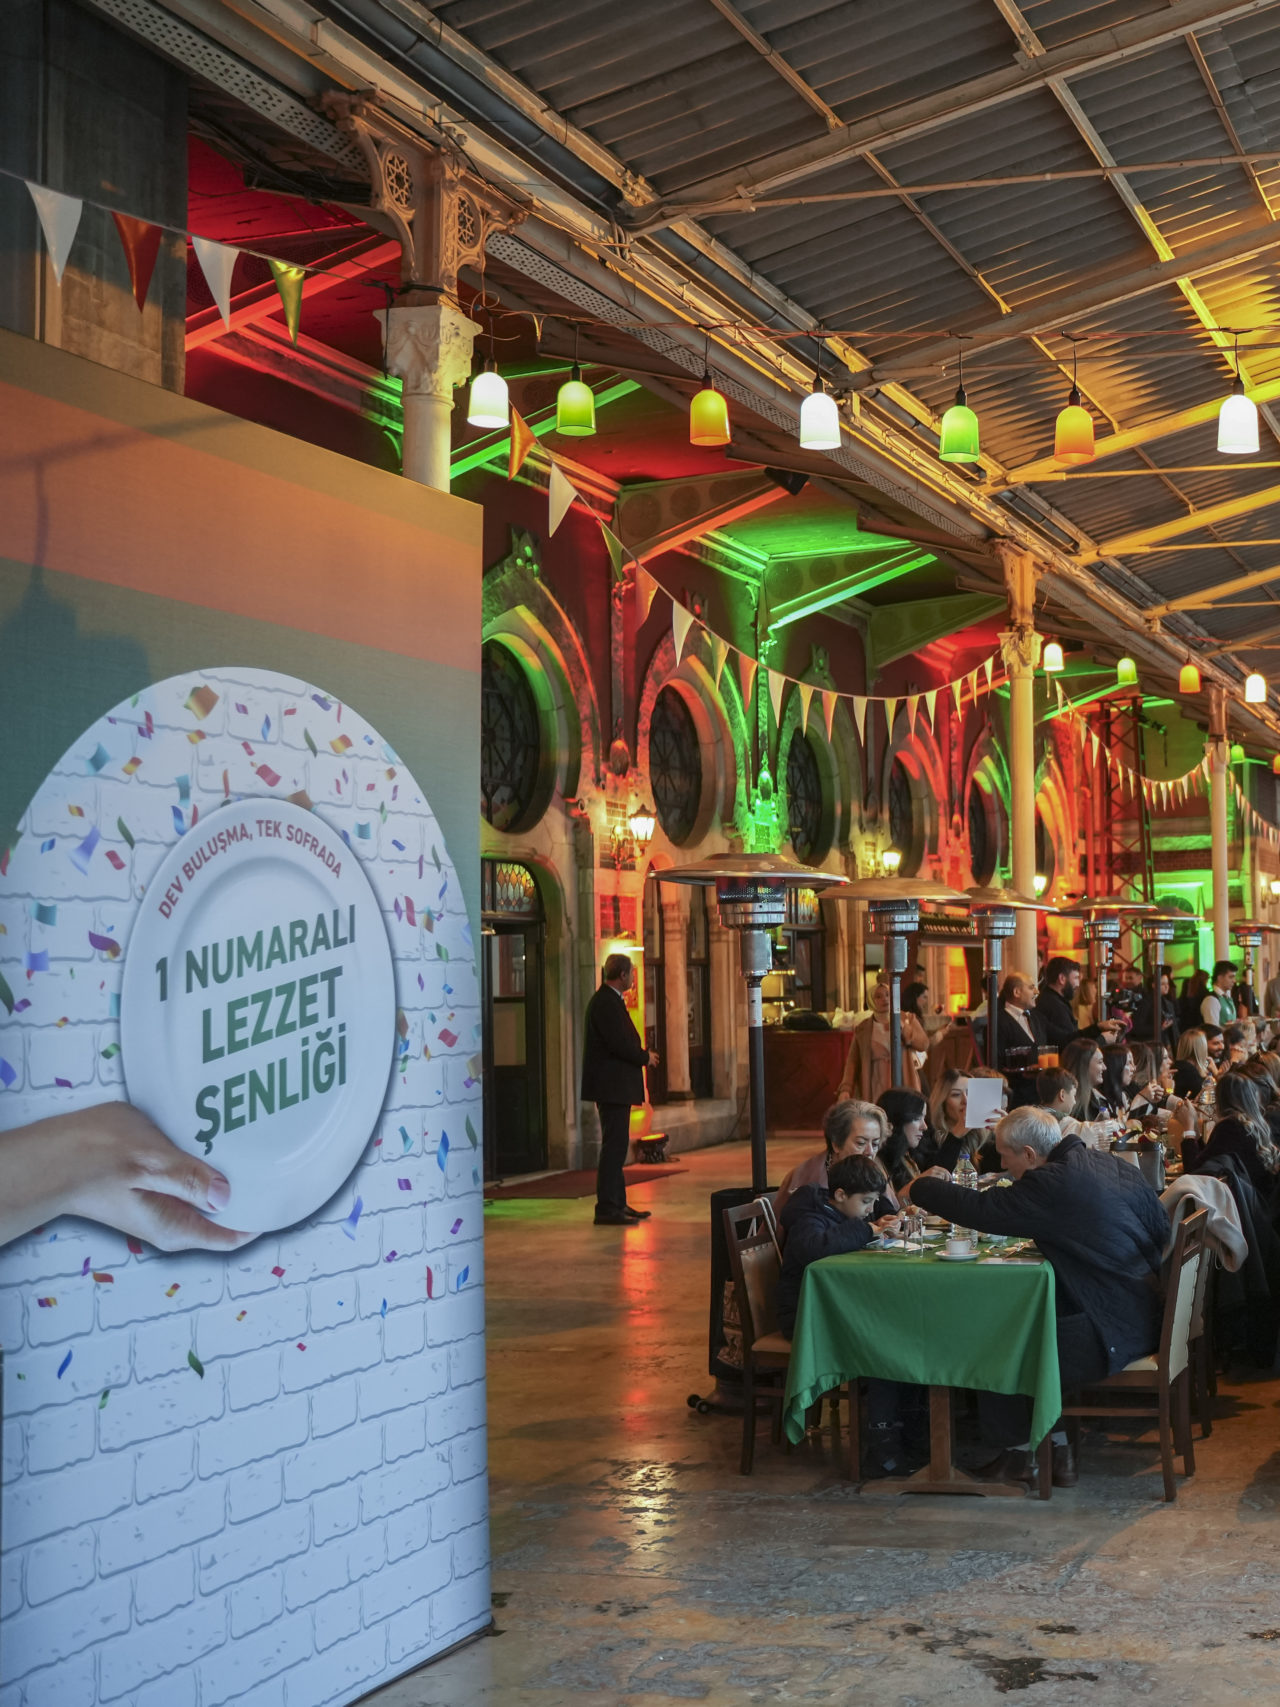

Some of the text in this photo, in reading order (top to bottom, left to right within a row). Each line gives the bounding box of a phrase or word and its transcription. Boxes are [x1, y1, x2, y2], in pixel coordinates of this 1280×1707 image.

[158, 820, 342, 919] DEV BULUŞMA, TEK SOFRADA
[155, 904, 356, 1002] 1 NUMARALI
[202, 965, 344, 1064] LEZZET
[194, 1022, 347, 1156] ŞENLİĞİ
